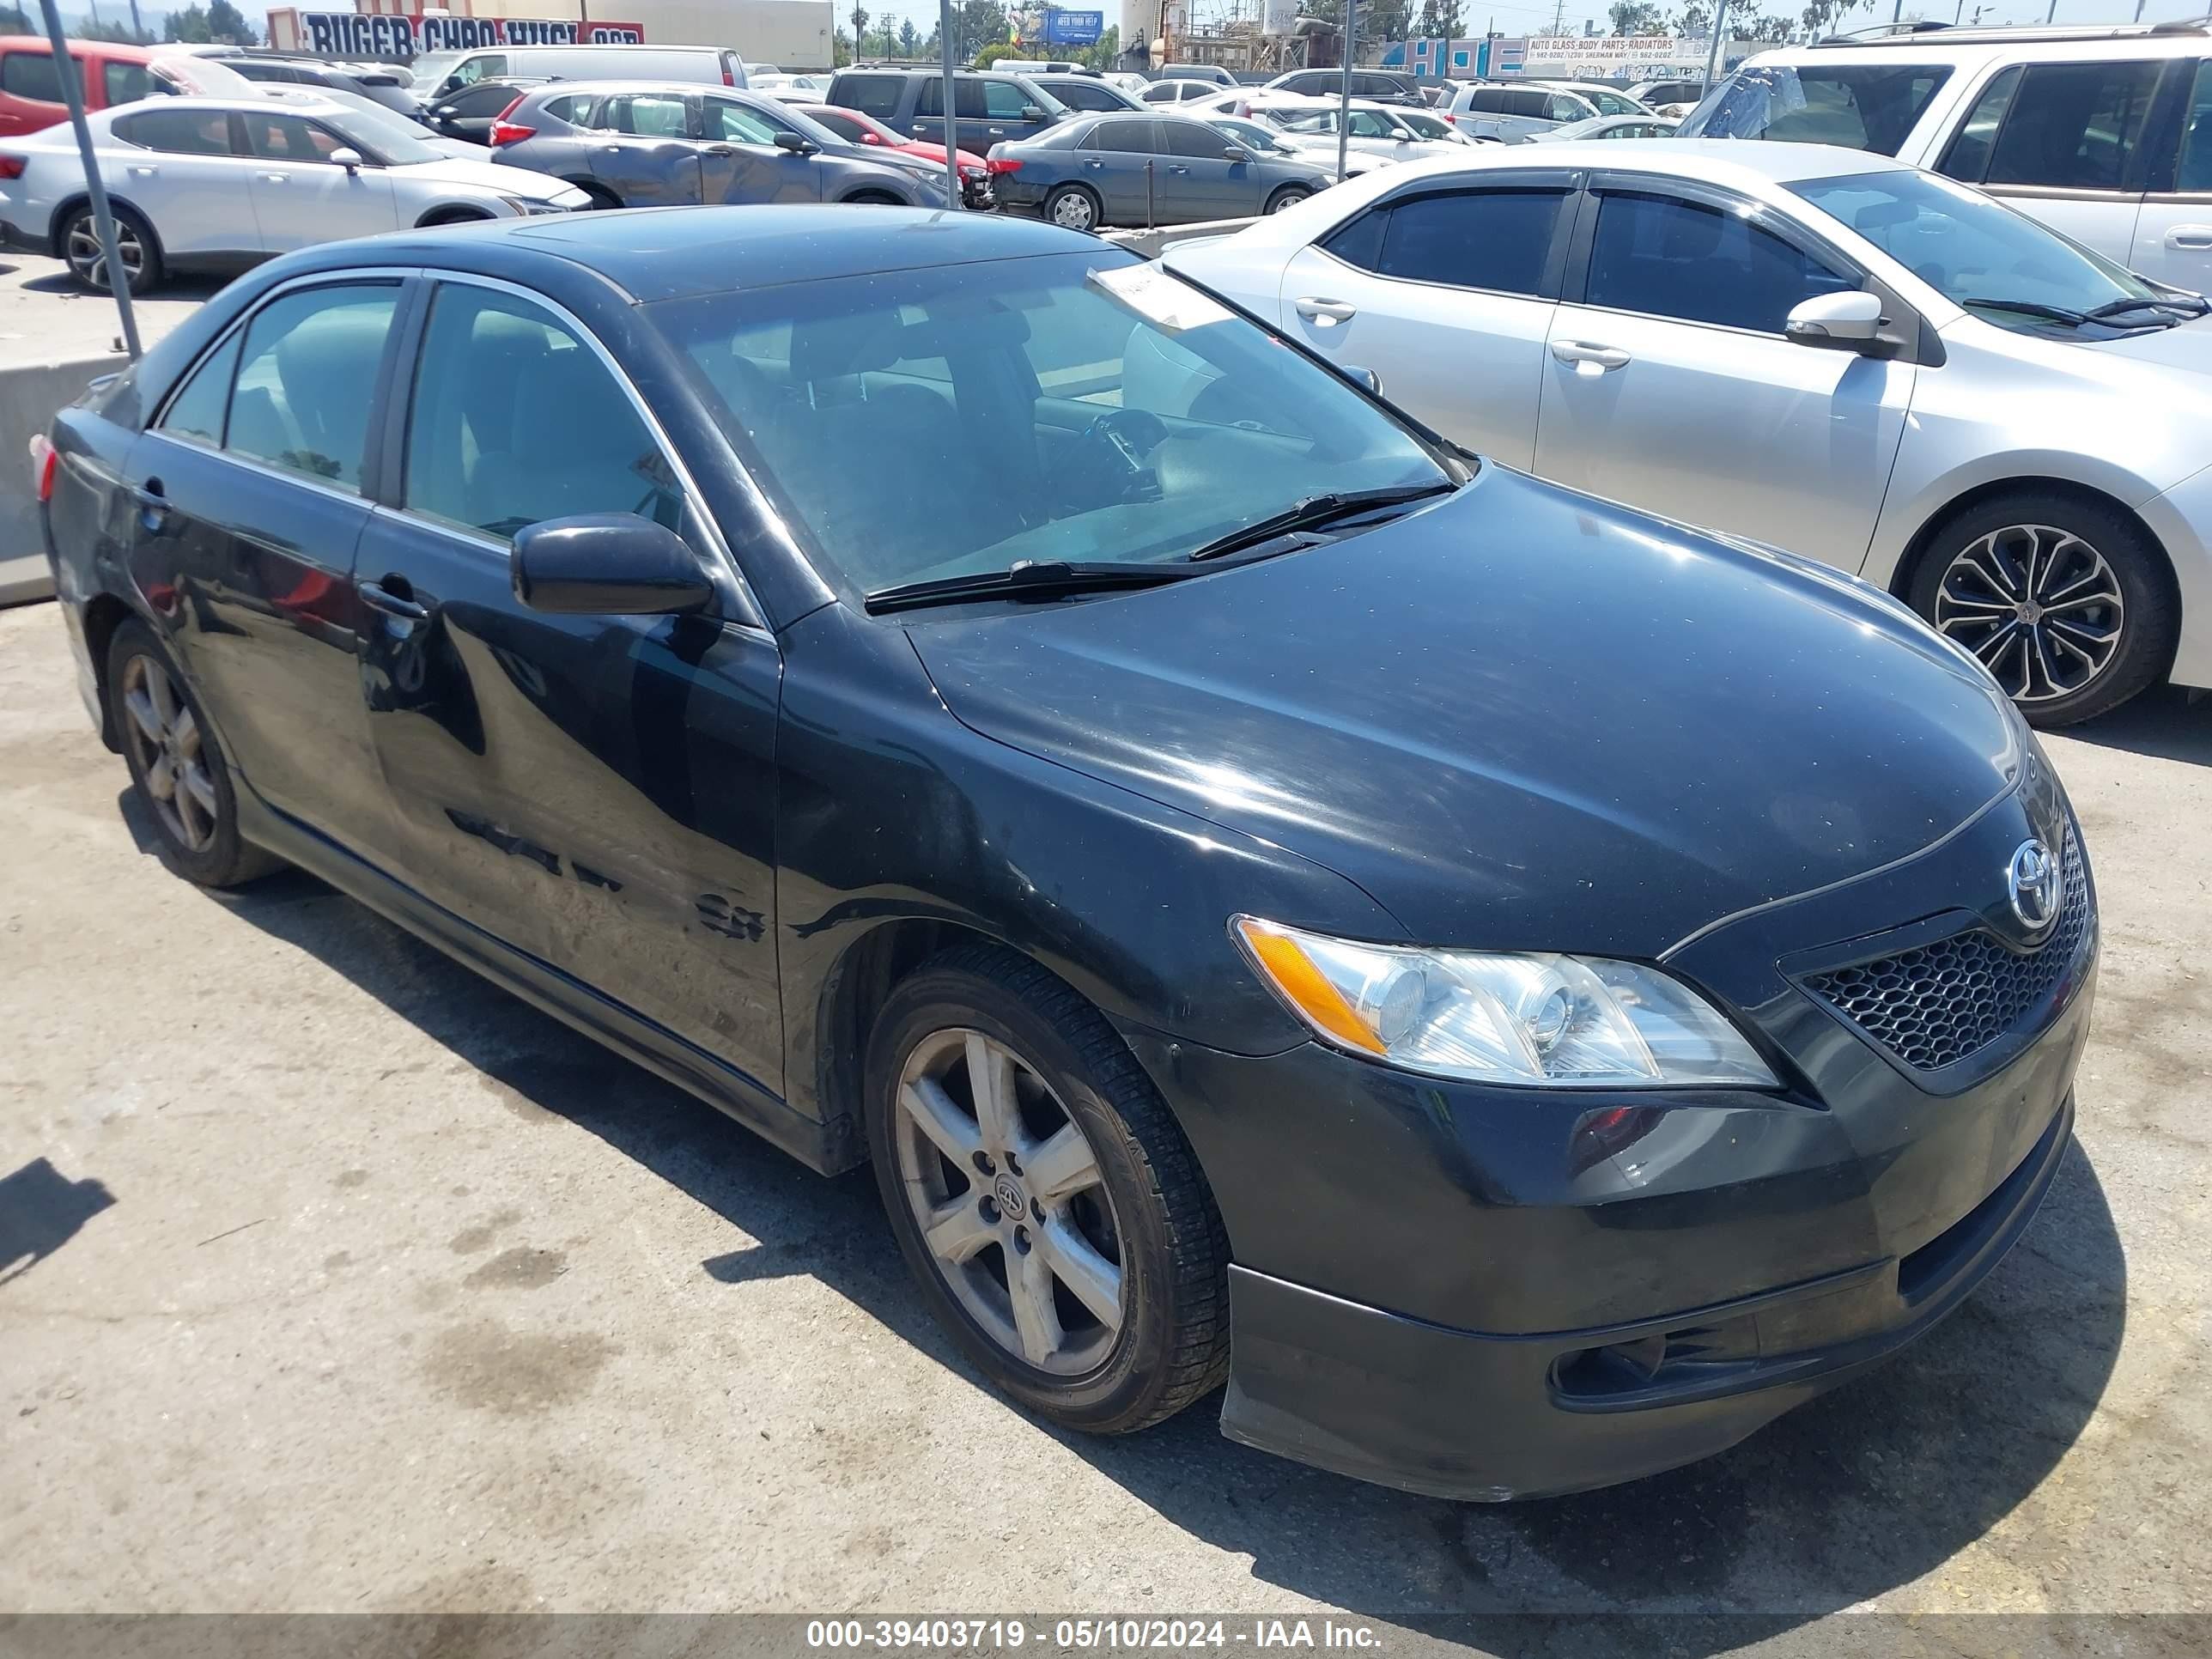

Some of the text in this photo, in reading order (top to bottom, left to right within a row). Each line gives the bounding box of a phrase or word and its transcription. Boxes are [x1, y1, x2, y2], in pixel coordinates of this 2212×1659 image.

[1057, 16, 1098, 27] NEED YOUR HELP
[1530, 40, 1550, 50] AUTO
